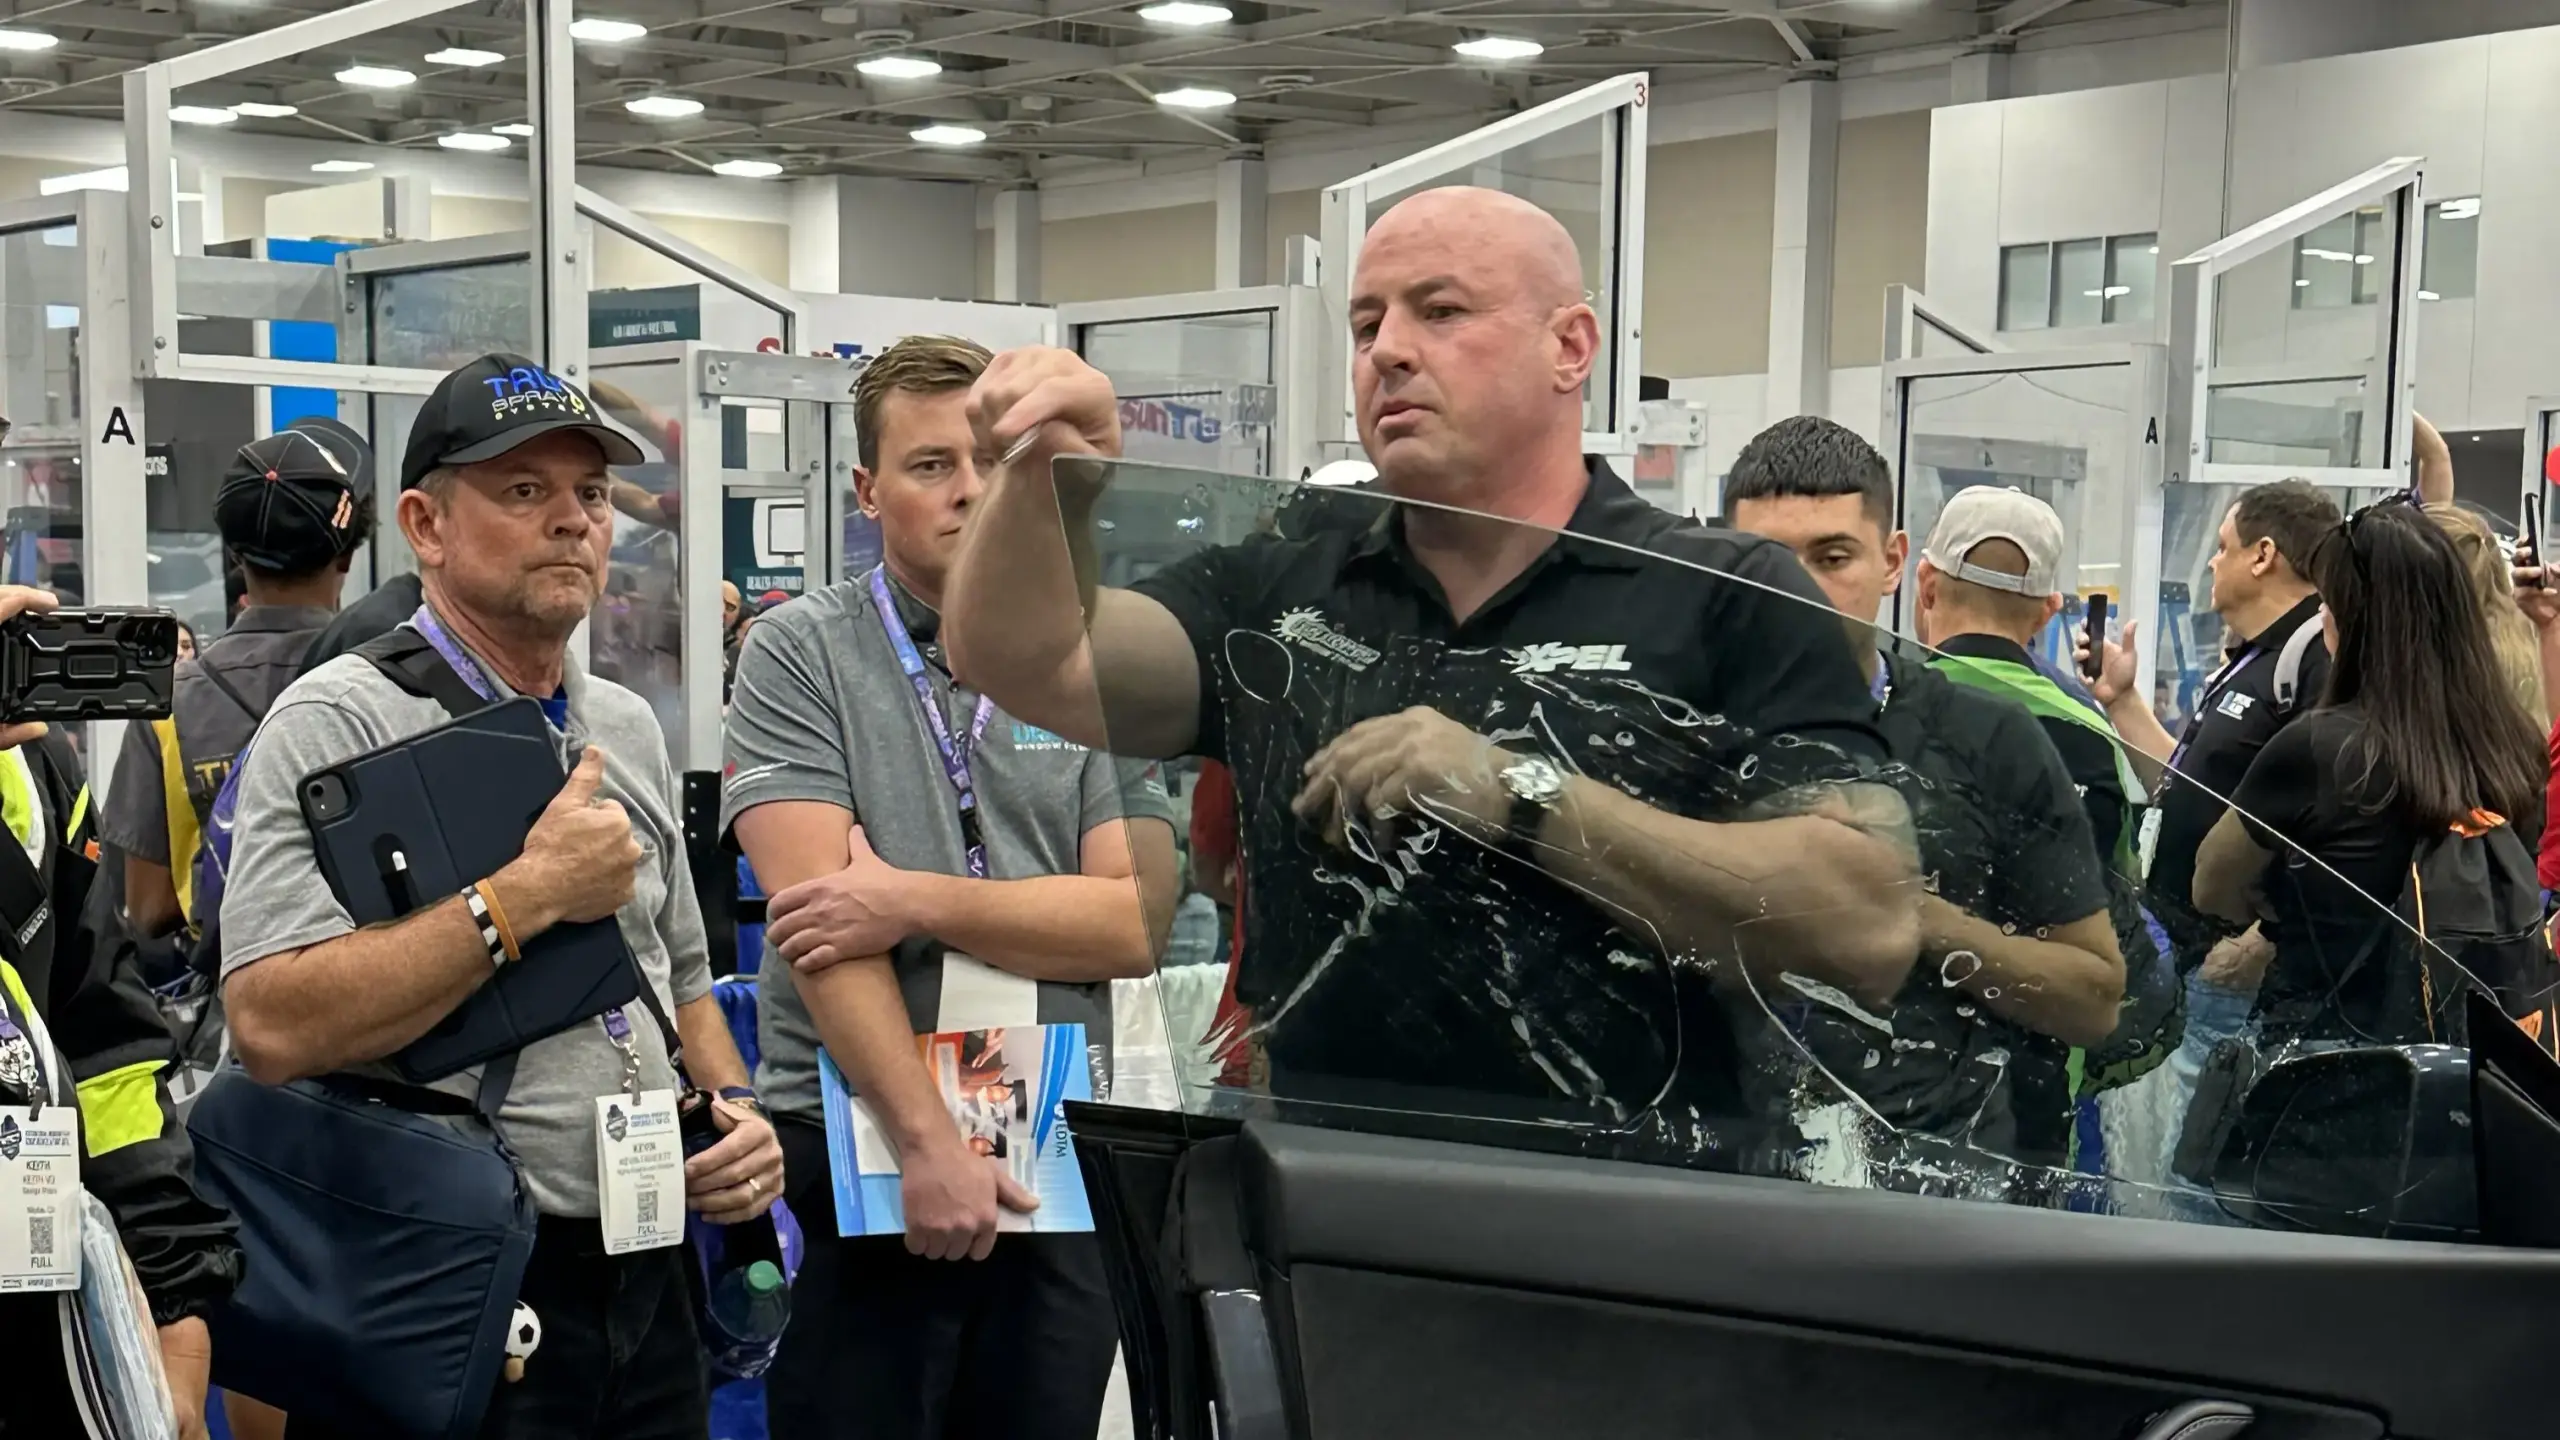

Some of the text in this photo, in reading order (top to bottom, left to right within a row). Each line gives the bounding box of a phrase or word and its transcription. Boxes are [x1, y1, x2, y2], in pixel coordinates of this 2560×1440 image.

[1634, 82, 1646, 108] 3
[101, 406, 136, 445] A
[2145, 416, 2158, 444] A
[1510, 641, 1633, 674] XPEL
